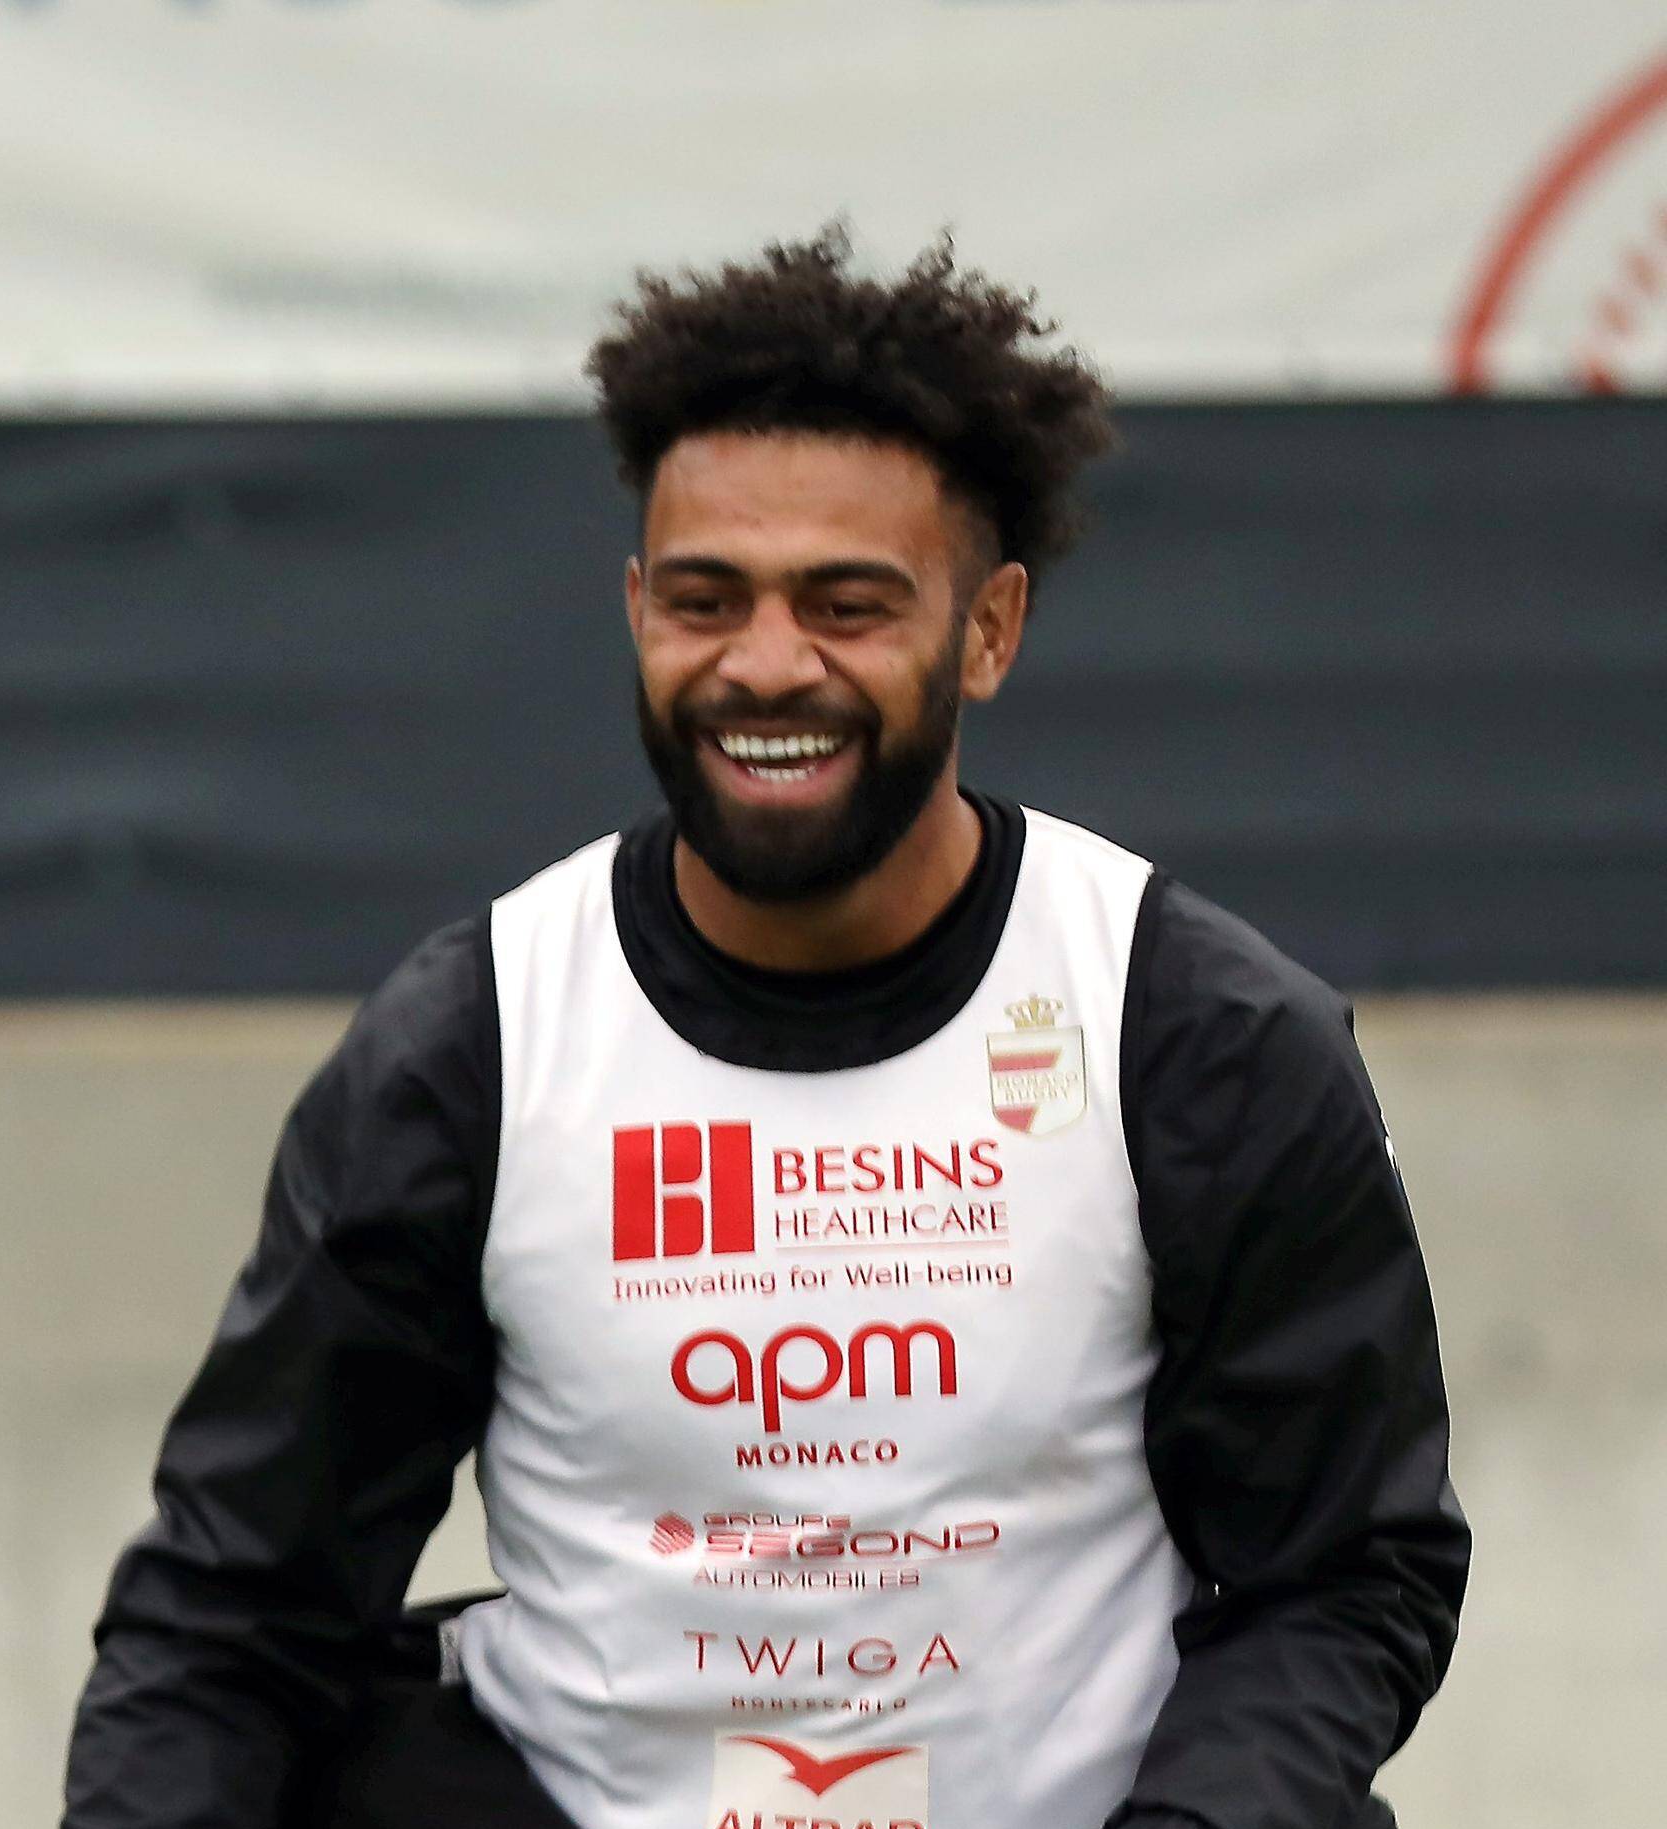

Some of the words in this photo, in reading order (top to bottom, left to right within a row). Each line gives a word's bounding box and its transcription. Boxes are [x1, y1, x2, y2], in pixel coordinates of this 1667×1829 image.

[772, 1137, 1004, 1195] BESINS
[774, 1200, 1010, 1241] HEALTHCARE
[612, 1267, 777, 1302] Innovating
[789, 1263, 833, 1290] for
[845, 1260, 1014, 1290] Well-being
[671, 1318, 958, 1434] apm
[735, 1438, 900, 1470] MONACO
[704, 1518, 1002, 1558] SEGOND
[692, 1565, 921, 1594] AUTOMOBILES
[683, 1629, 961, 1679] TWIGA
